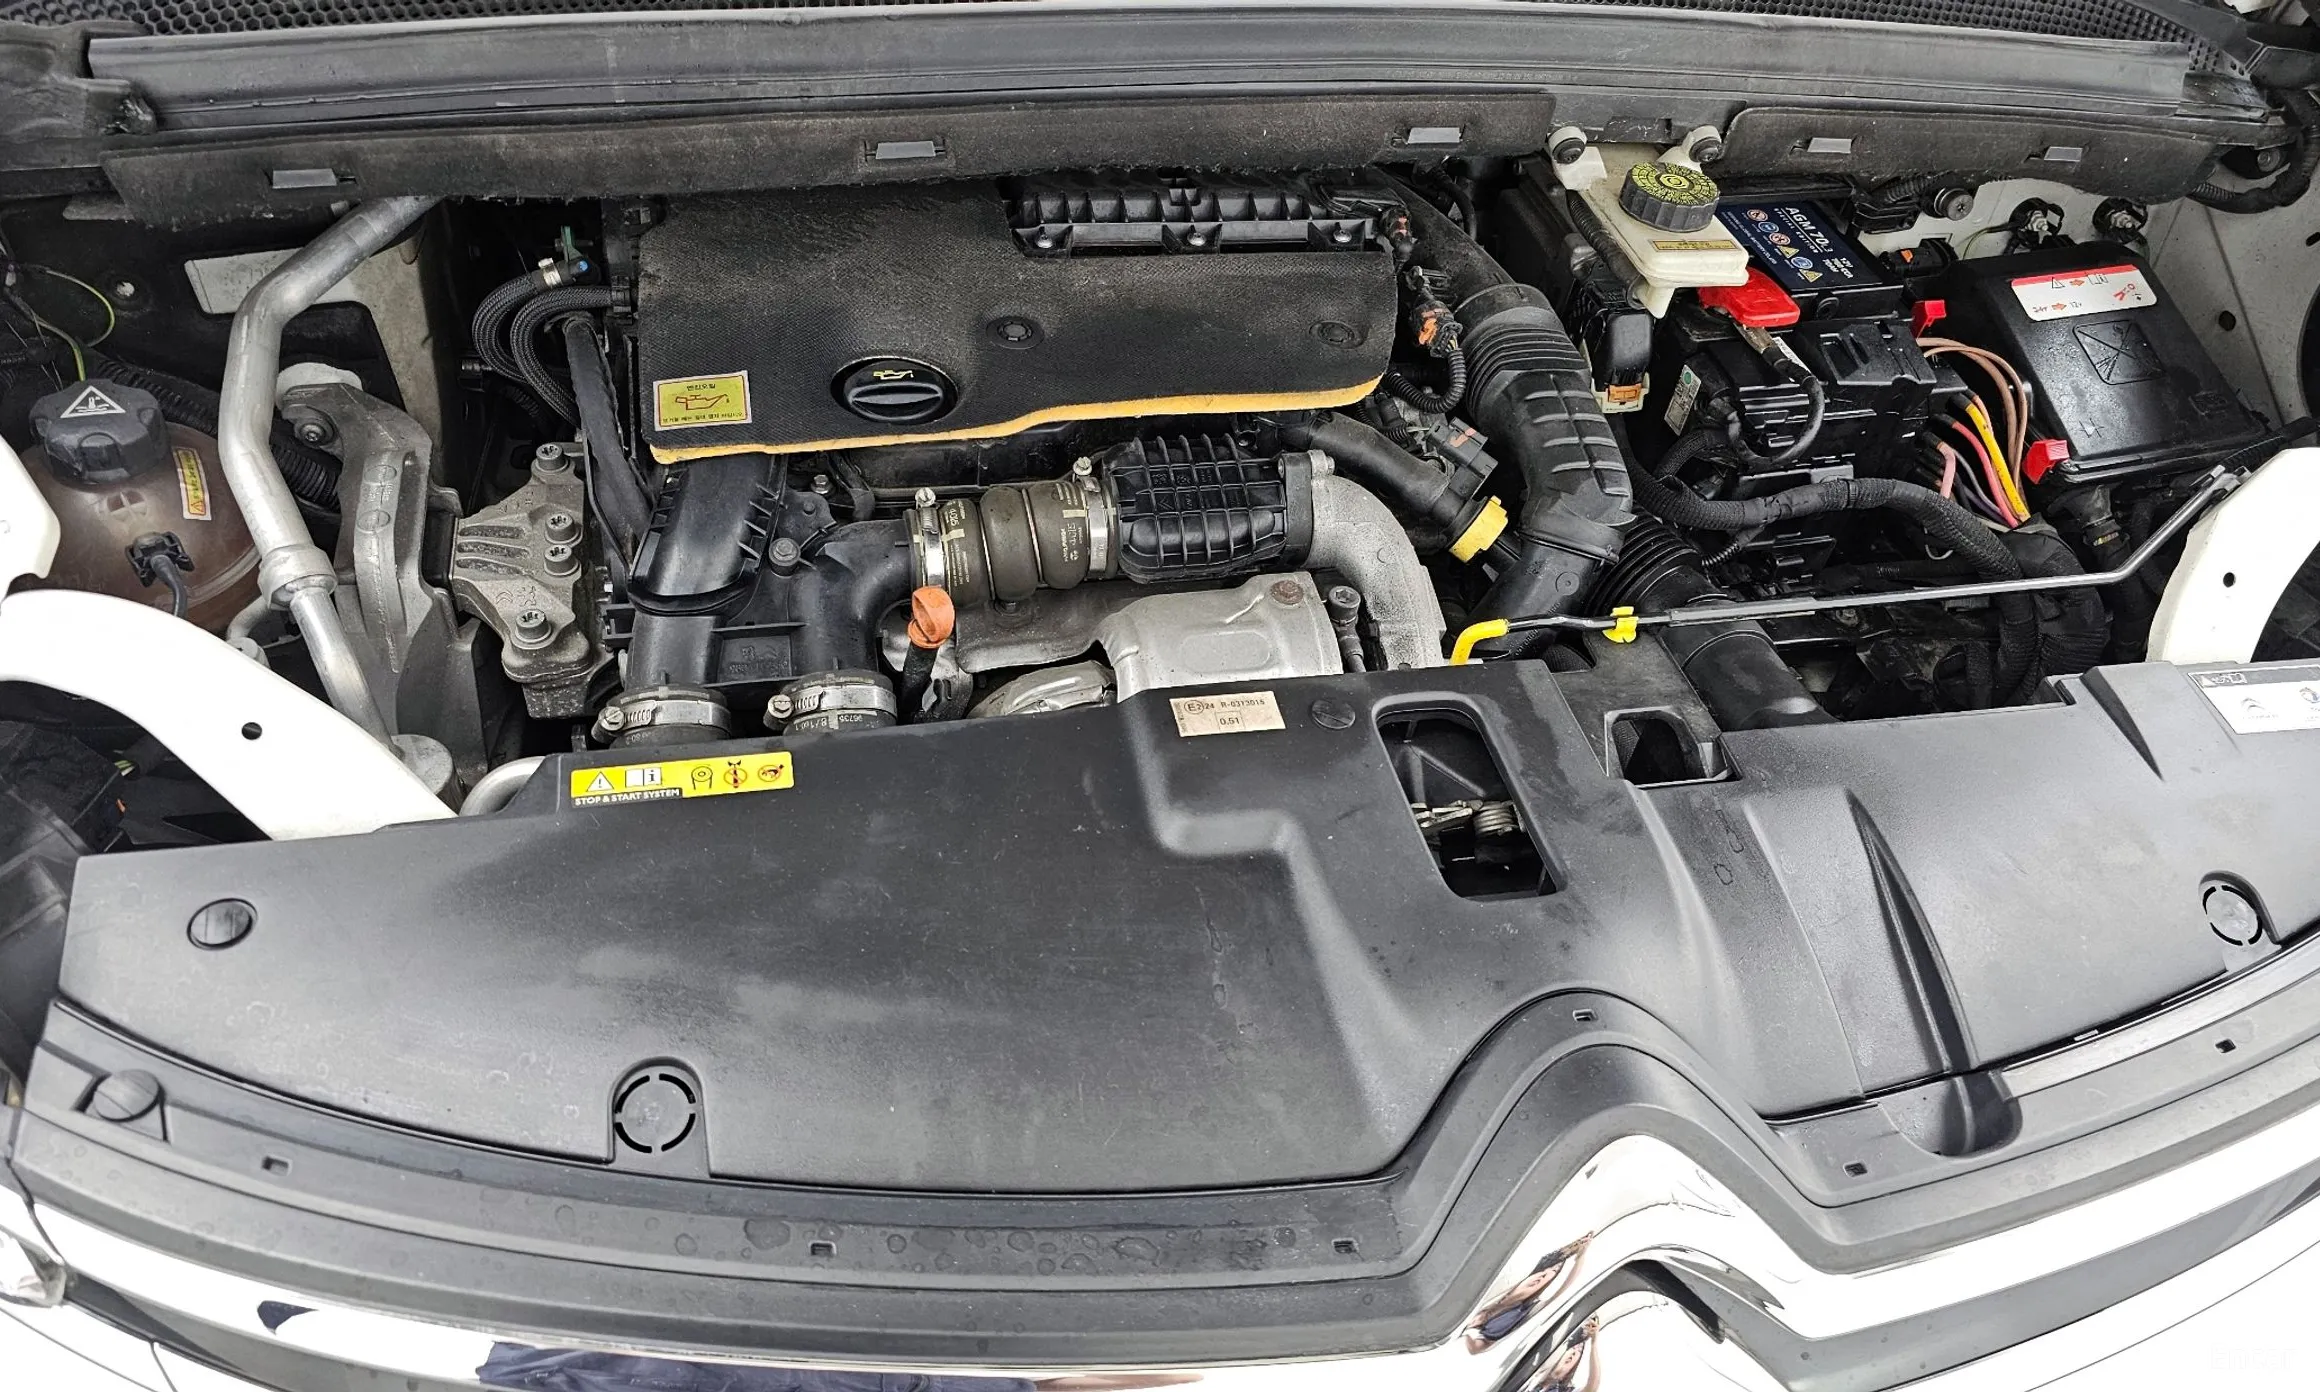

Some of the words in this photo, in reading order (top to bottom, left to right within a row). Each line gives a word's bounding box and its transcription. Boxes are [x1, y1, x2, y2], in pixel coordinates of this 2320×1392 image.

[1773, 207, 1796, 230] SPECIAL
[1796, 230, 1819, 254] EDITION
[1786, 206, 1816, 231] AGM
[575, 796, 601, 806] STOP
[602, 794, 611, 803] &
[611, 792, 642, 803] START
[643, 788, 680, 800] SYSTEM
